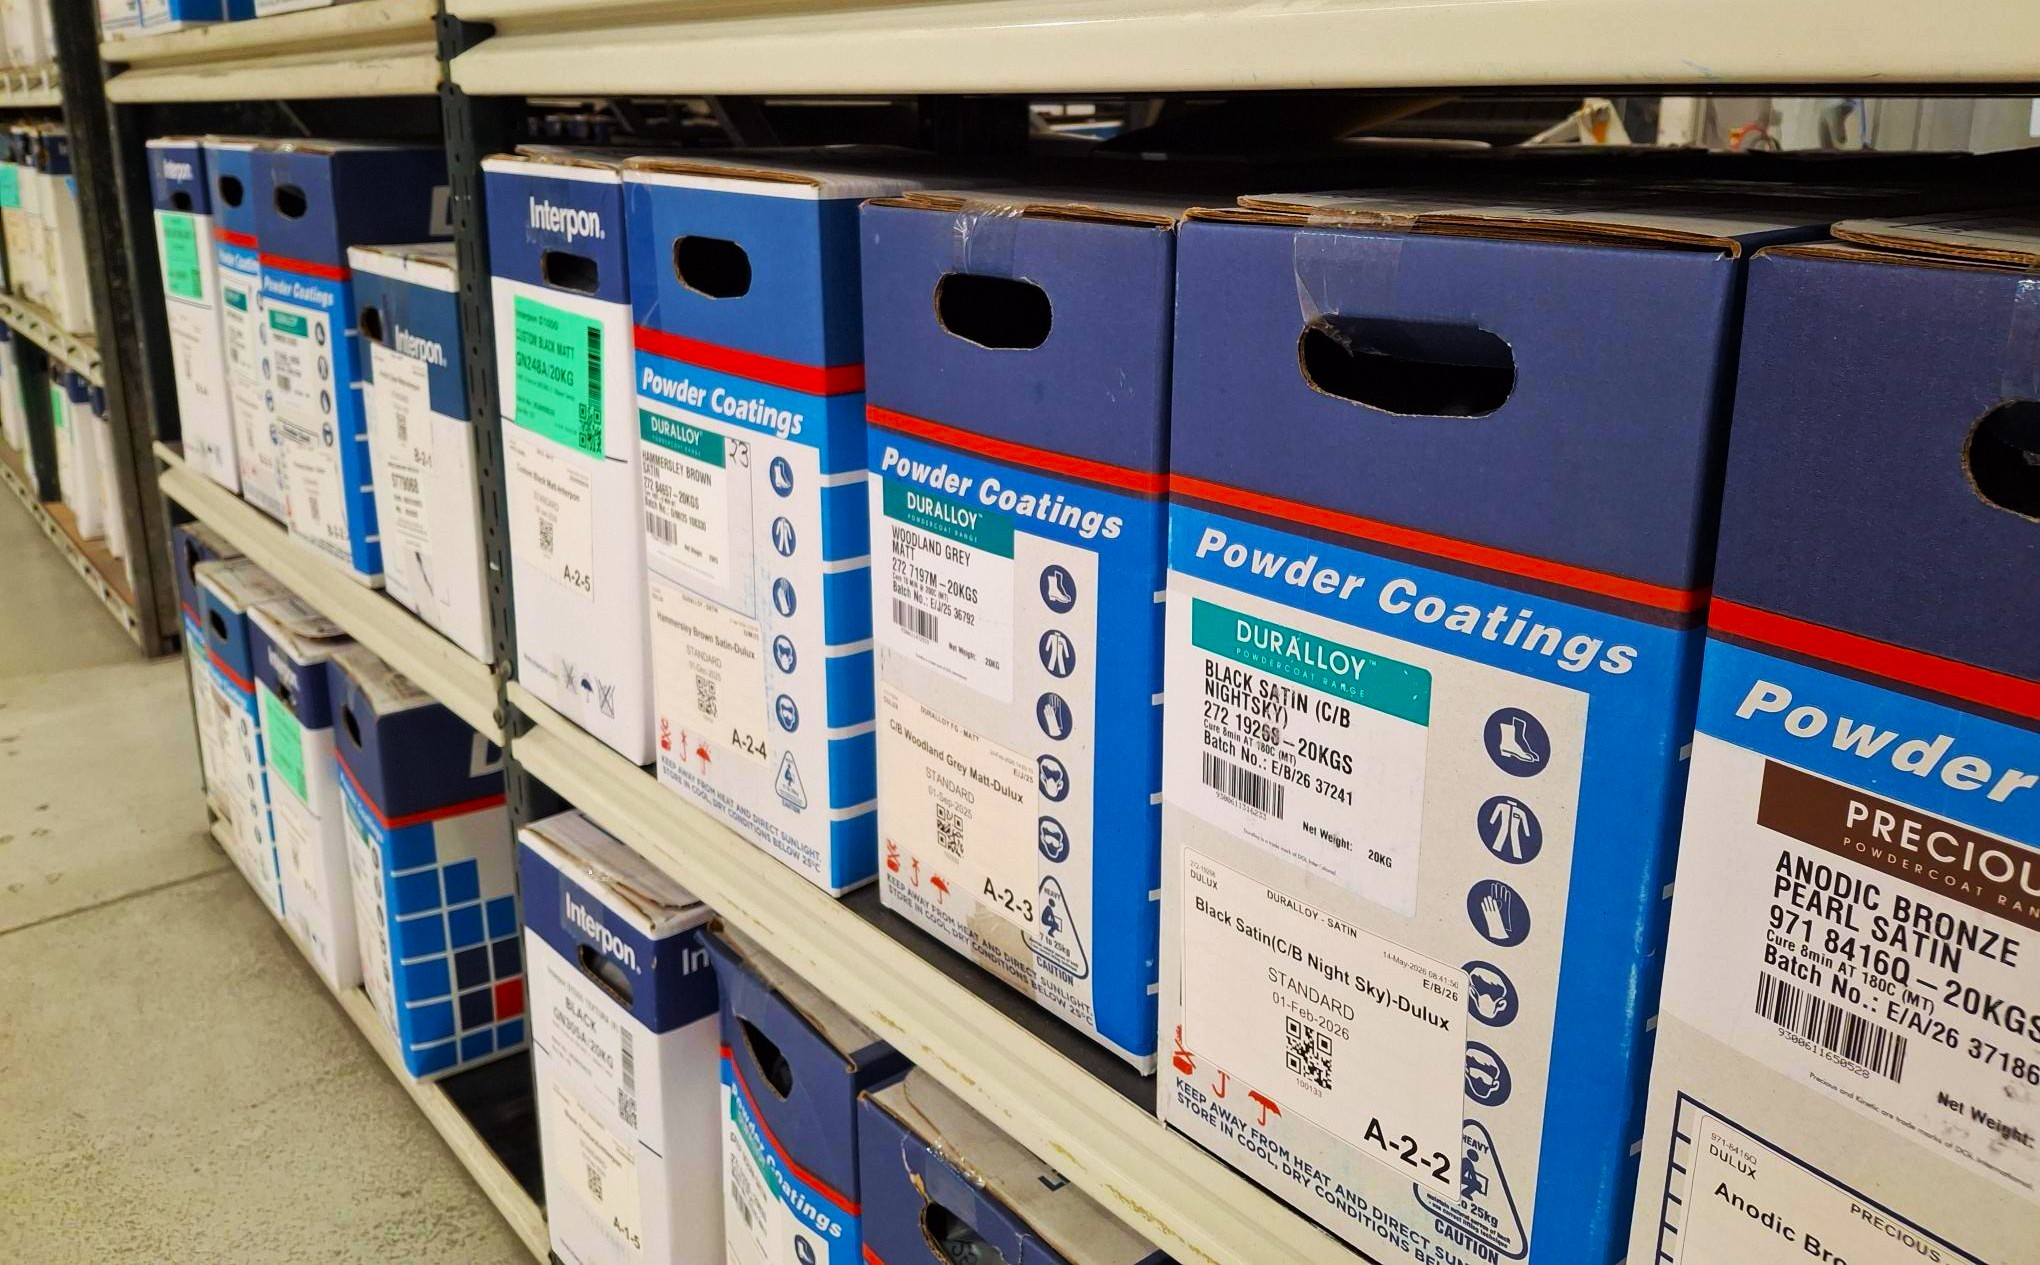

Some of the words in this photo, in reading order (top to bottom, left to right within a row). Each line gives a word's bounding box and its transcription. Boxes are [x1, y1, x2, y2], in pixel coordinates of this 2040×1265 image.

[556, 343, 575, 360] MATT
[642, 366, 707, 408] Powder
[711, 387, 804, 440] Coatings
[651, 416, 700, 446] DURALLOY
[642, 450, 685, 476] HAMMERSLEY
[686, 466, 712, 487] BROWN
[881, 446, 973, 498] Powder
[979, 477, 1124, 540] Coatings
[892, 524, 942, 557] WOODLAND
[945, 544, 971, 567] GREY
[892, 540, 915, 561] MATT
[907, 514, 951, 536] POWDERCOAT
[954, 529, 978, 544] RANGE
[563, 564, 591, 593] A-2-5
[892, 557, 907, 576] 272
[893, 580, 911, 600] Batch
[930, 597, 951, 616] E/J/25
[954, 607, 975, 626] 36792
[1194, 526, 1366, 602] Powder
[1377, 577, 1639, 676] Coatings
[686, 645, 722, 669] STANDARD
[693, 626, 714, 643] Brown
[985, 657, 1000, 670] 20KG
[1235, 646, 1316, 683] POWDERCOAT
[1322, 678, 1366, 699] RANGE
[1203, 699, 1229, 726] 272
[1204, 658, 1253, 694] BLACK
[1259, 679, 1309, 714] SATIN
[1315, 699, 1351, 729] (C/B
[1204, 677, 1289, 730] NIGHTSKY)
[731, 728, 768, 760] A-2-4
[889, 718, 903, 735] C/B
[904, 728, 944, 761] Woodland
[946, 754, 968, 776] Grey
[969, 766, 1024, 804] Matt-Dulux
[1203, 718, 1221, 735] Cure
[1222, 724, 1241, 743] 8min
[1243, 734, 1255, 749] AT
[1278, 745, 1297, 767] (MT)
[1734, 679, 2040, 804] Powder
[925, 766, 975, 805] STANDARD
[1013, 767, 1034, 784] E/J/25
[1204, 729, 1236, 758] Batch
[1271, 760, 1311, 790] E/B/26
[1315, 778, 1353, 807] 37241
[713, 799, 727, 814] DRY
[727, 808, 771, 844] CONDITIONS
[772, 837, 801, 862] BELOW
[736, 804, 751, 820] AND
[752, 812, 779, 837] DIRECT
[1302, 820, 1318, 837] Net
[1320, 827, 1354, 853] Weight:
[1368, 848, 1393, 869] 20KG
[1190, 868, 1218, 891] DULUX
[1842, 836, 1985, 898] POWDERCOAT
[983, 876, 1034, 923] A-2-3
[1043, 886, 1062, 902] HEAVY
[1266, 889, 1319, 922] DURALLOY
[1327, 917, 1358, 939] SATIN
[1775, 849, 1881, 912] ANODIC
[1892, 895, 2022, 969] BRONZE
[887, 873, 906, 892] KEEP
[907, 887, 930, 909] AWAY
[931, 902, 956, 927] FROM
[957, 919, 979, 942] HEAT
[982, 936, 1001, 957] AND
[1004, 951, 1037, 982] DIRECT
[889, 885, 913, 911] STORE
[952, 928, 970, 947] DRY
[972, 940, 1030, 984] CONDITIONS
[1030, 978, 1067, 1009] BELOW
[1769, 904, 1813, 943] 971
[1773, 875, 1860, 933] PEARL
[1870, 915, 1963, 974] SATIN
[1036, 954, 1074, 987] CAUTION
[1194, 896, 1232, 928] Black
[1236, 916, 1304, 963] Satin(C/B
[1307, 951, 1351, 988] Night
[1354, 975, 1451, 1033] Sky)-Dulux
[1766, 929, 1796, 953] Cure
[1800, 941, 1834, 970] 8min
[1837, 961, 1857, 979] AT
[1862, 971, 1897, 998] 180C
[1901, 988, 1936, 1017] (MT)
[1268, 966, 1356, 1021] STANDARD
[1423, 978, 1459, 1002] E/B/26
[566, 996, 596, 1033] BLACK
[1272, 991, 1350, 1041] 01-Feb-2026
[1763, 943, 1823, 988] Batch
[1831, 974, 1878, 1014] No.:
[1886, 1000, 1960, 1050] E/A/26
[1967, 1037, 2040, 1086] 37186
[1777, 1026, 1871, 1080] 9300611650528
[1296, 1077, 1322, 1099] 100133
[1808, 1071, 1838, 1092] Precious
[1937, 1091, 1964, 1116] Net
[1176, 1077, 1207, 1104] KEEP
[1209, 1097, 1248, 1133] AWAY
[1251, 1127, 1290, 1162] FROM
[1294, 1155, 1331, 1188] HEAT
[1335, 1183, 1368, 1211] AND
[1372, 1206, 1431, 1250] DIRECT
[1177, 1091, 1217, 1128] STORE
[1220, 1117, 1234, 1138] IN
[1237, 1131, 1279, 1170] COOL,
[1282, 1162, 1311, 1188] DRY
[1314, 1185, 1410, 1253] CONDITIONS
[1363, 1117, 1451, 1185] A-2-2
[1708, 1143, 1757, 1181] DULUX
[766, 1154, 843, 1239] Coatings
[1470, 1202, 1499, 1229] 25kg
[1714, 1182, 1796, 1243] Anodic
[612, 1215, 641, 1251] A-1-5
[1434, 1217, 1499, 1265] CAUTION
[1849, 1202, 1942, 1264] PRECIOUS
